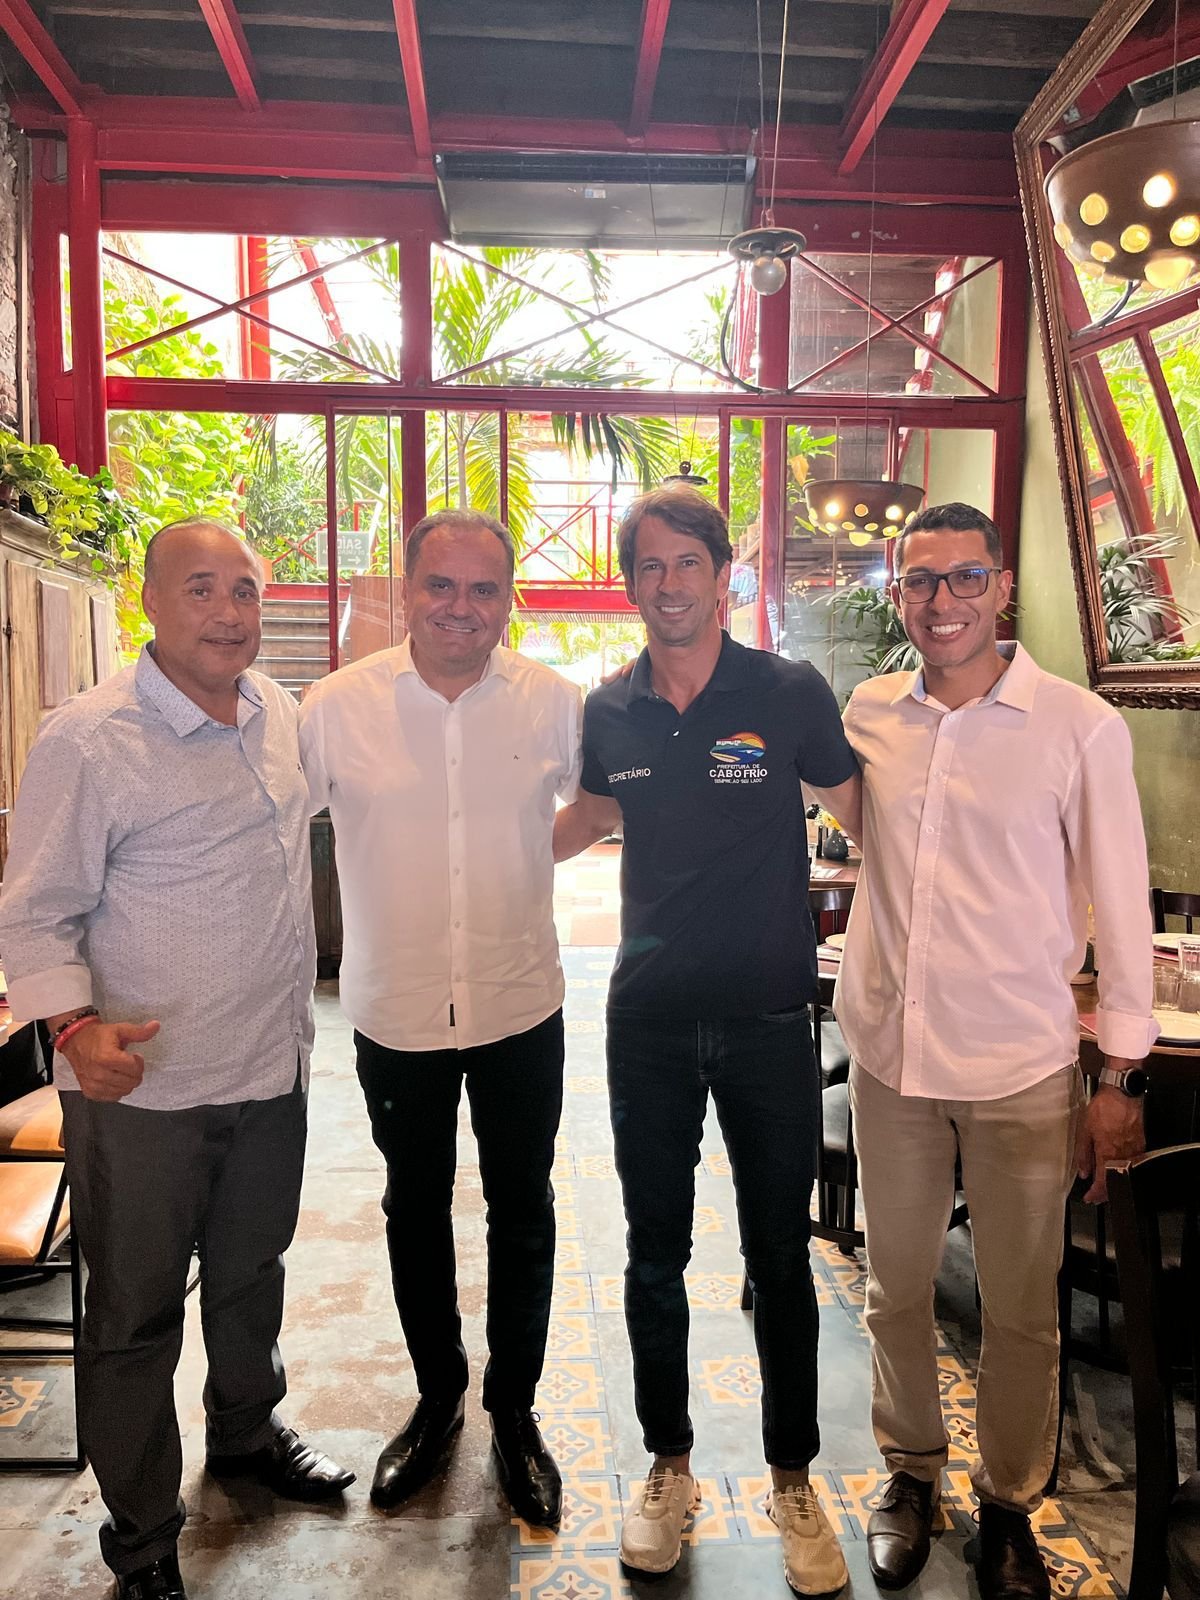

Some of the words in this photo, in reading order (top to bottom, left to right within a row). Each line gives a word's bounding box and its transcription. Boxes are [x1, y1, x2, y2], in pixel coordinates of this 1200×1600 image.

[608, 766, 651, 783] SECRETÁRIO
[709, 769, 742, 778] CABO
[743, 768, 768, 778] FRIO
